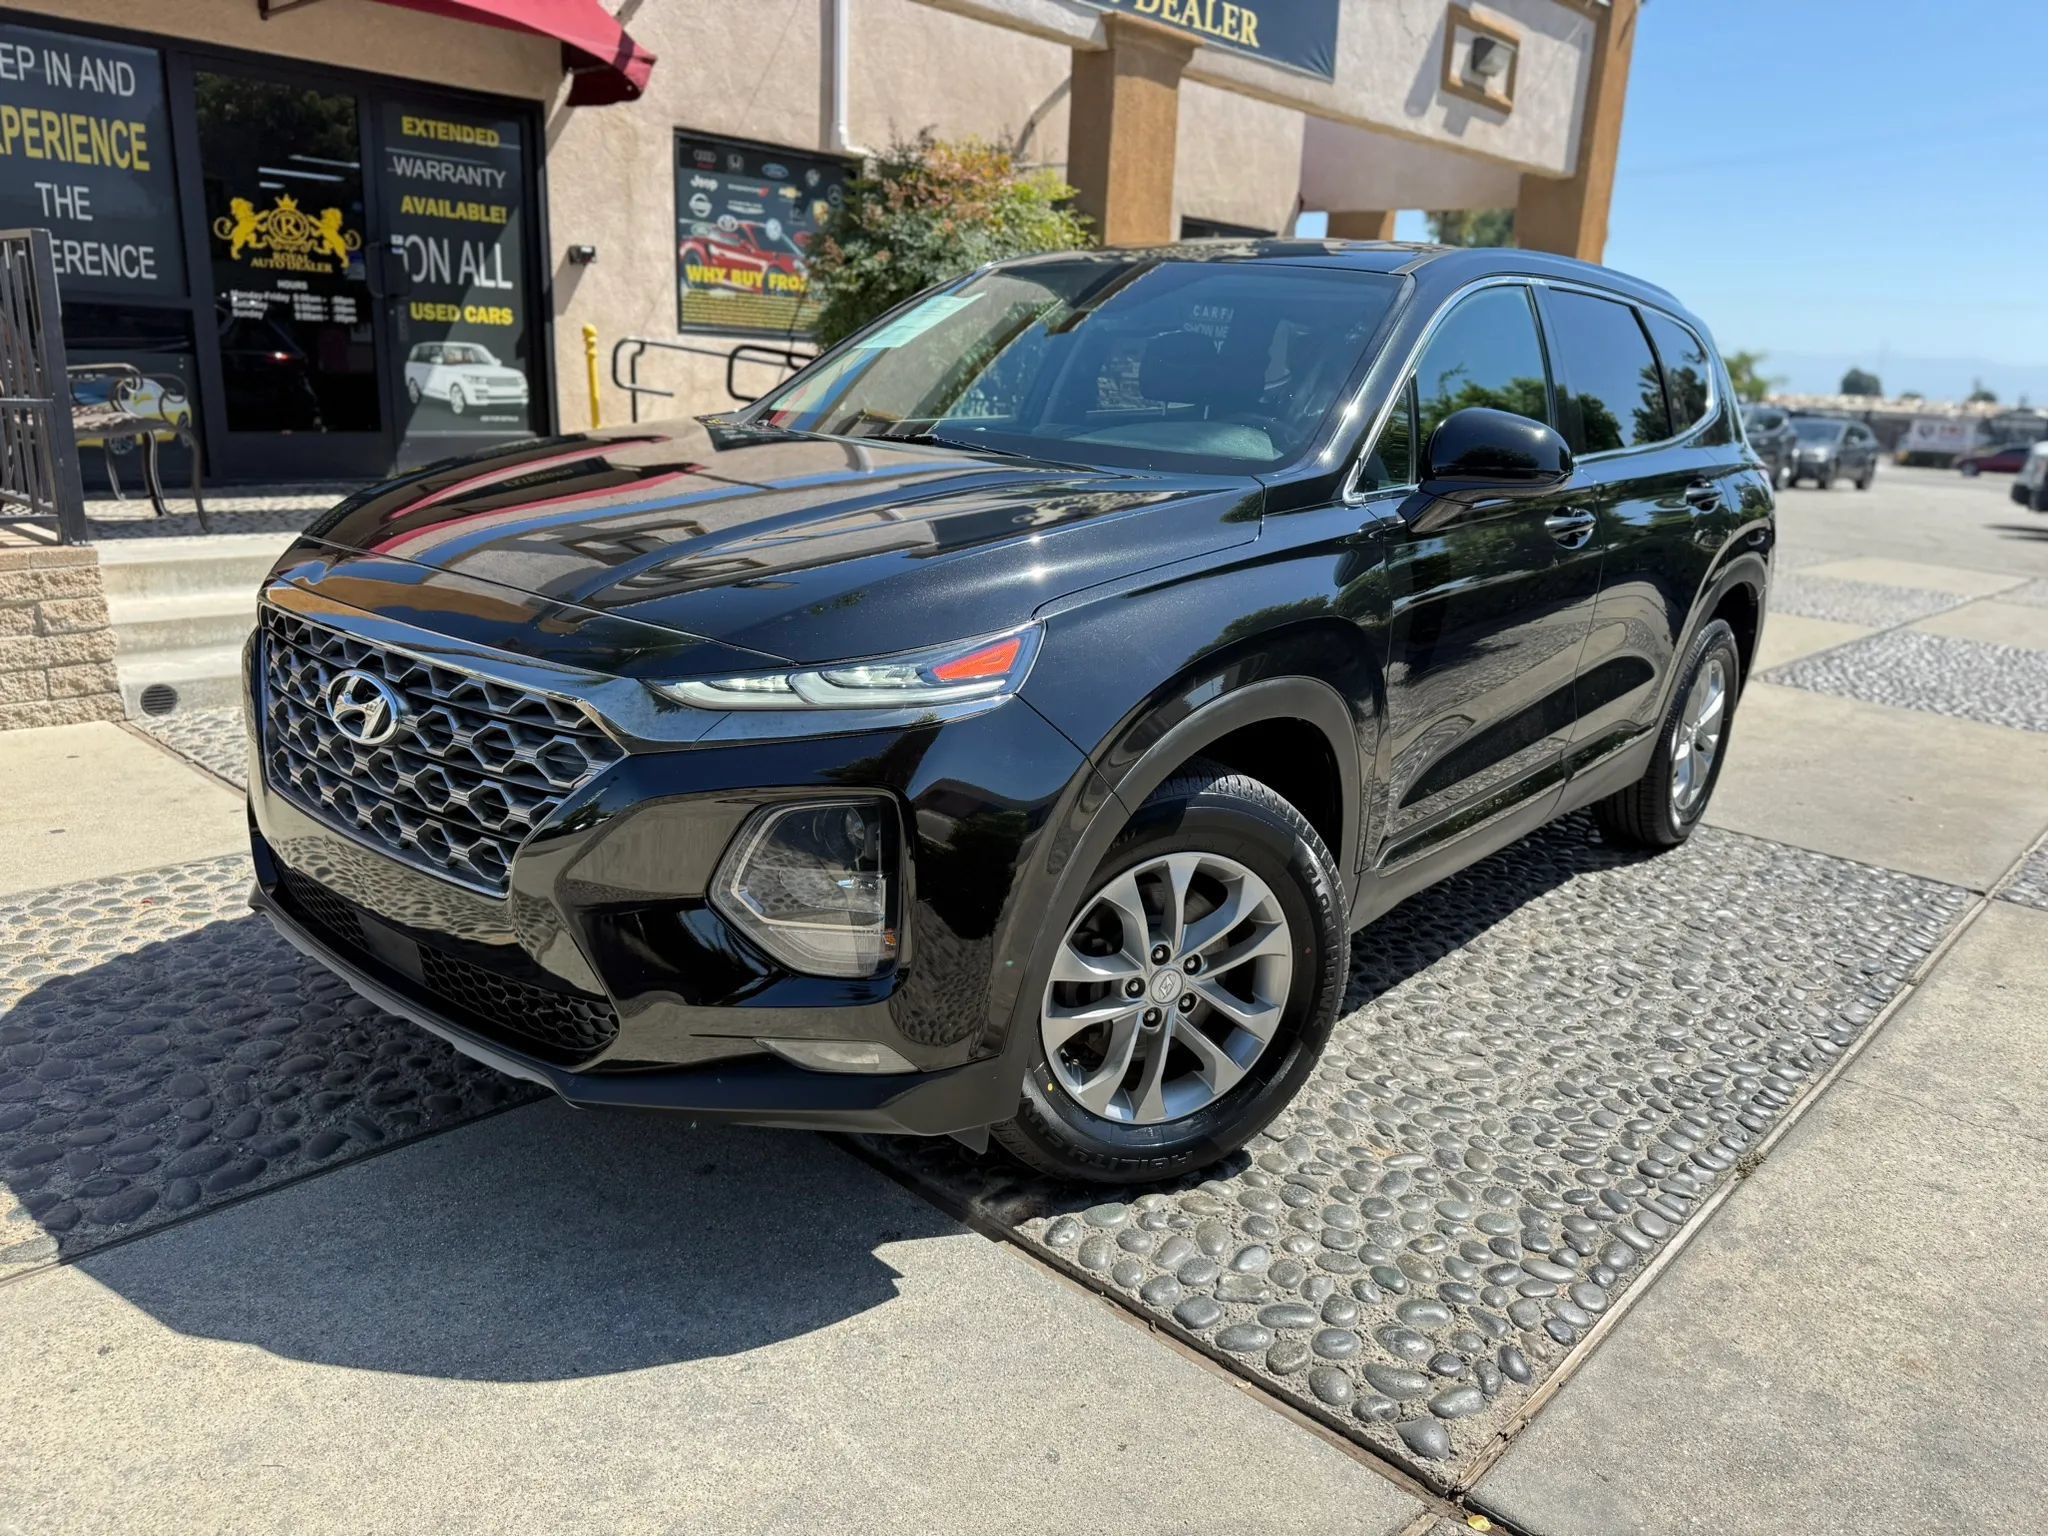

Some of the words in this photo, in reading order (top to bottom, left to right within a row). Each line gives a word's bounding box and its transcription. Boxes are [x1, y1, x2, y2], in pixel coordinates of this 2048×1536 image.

[43, 50, 73, 89] IN
[79, 56, 136, 97] AND
[0, 104, 150, 171] PERIENCE
[401, 116, 500, 147] EXTENDED
[393, 156, 506, 189] WARRANTY
[34, 182, 93, 221] THE
[401, 195, 507, 224] AVAILABLE!
[403, 234, 451, 284] ON
[458, 240, 514, 289] ALL
[685, 264, 726, 284] WHY
[731, 268, 764, 288] BUY
[410, 302, 461, 322] USED
[464, 305, 514, 326] CARS
